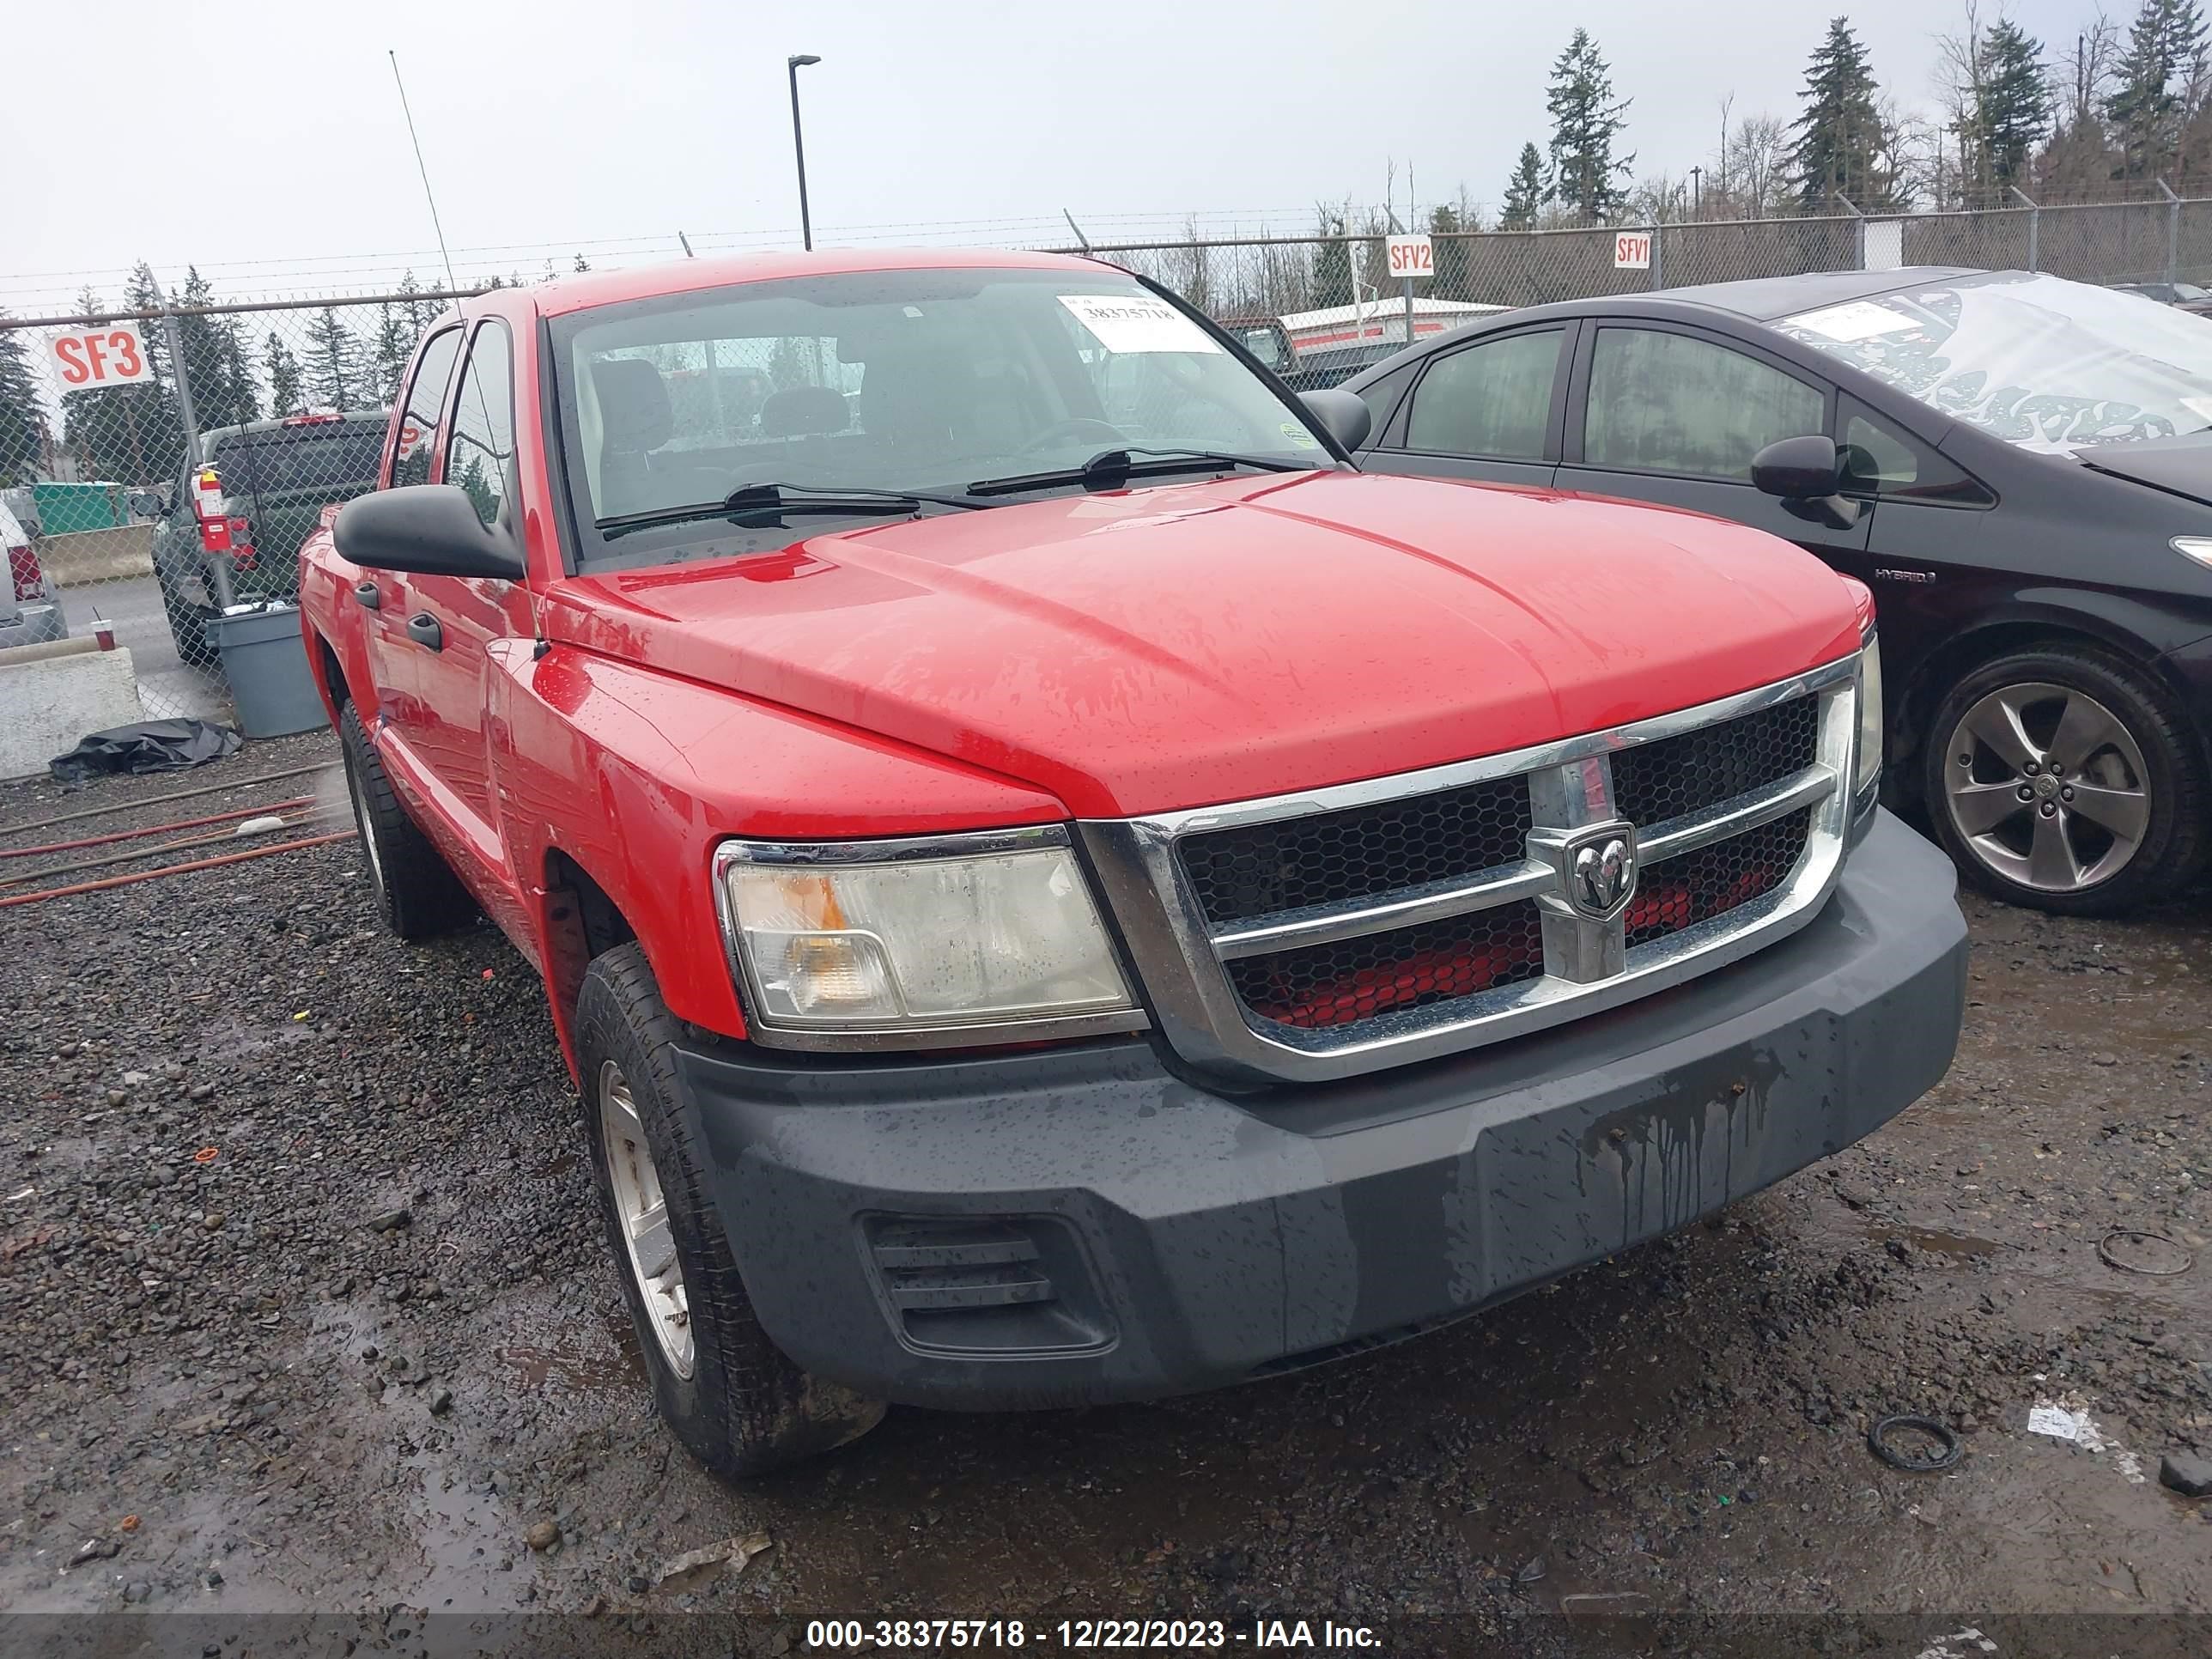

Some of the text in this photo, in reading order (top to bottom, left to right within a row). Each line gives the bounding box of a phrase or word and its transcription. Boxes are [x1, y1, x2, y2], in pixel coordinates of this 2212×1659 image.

[1391, 245, 1432, 270] SFV2
[1618, 238, 1649, 262] SFV1
[1084, 307, 1176, 320] 38375718
[55, 331, 142, 384] SF3
[1875, 568, 1926, 583] HYBRID
